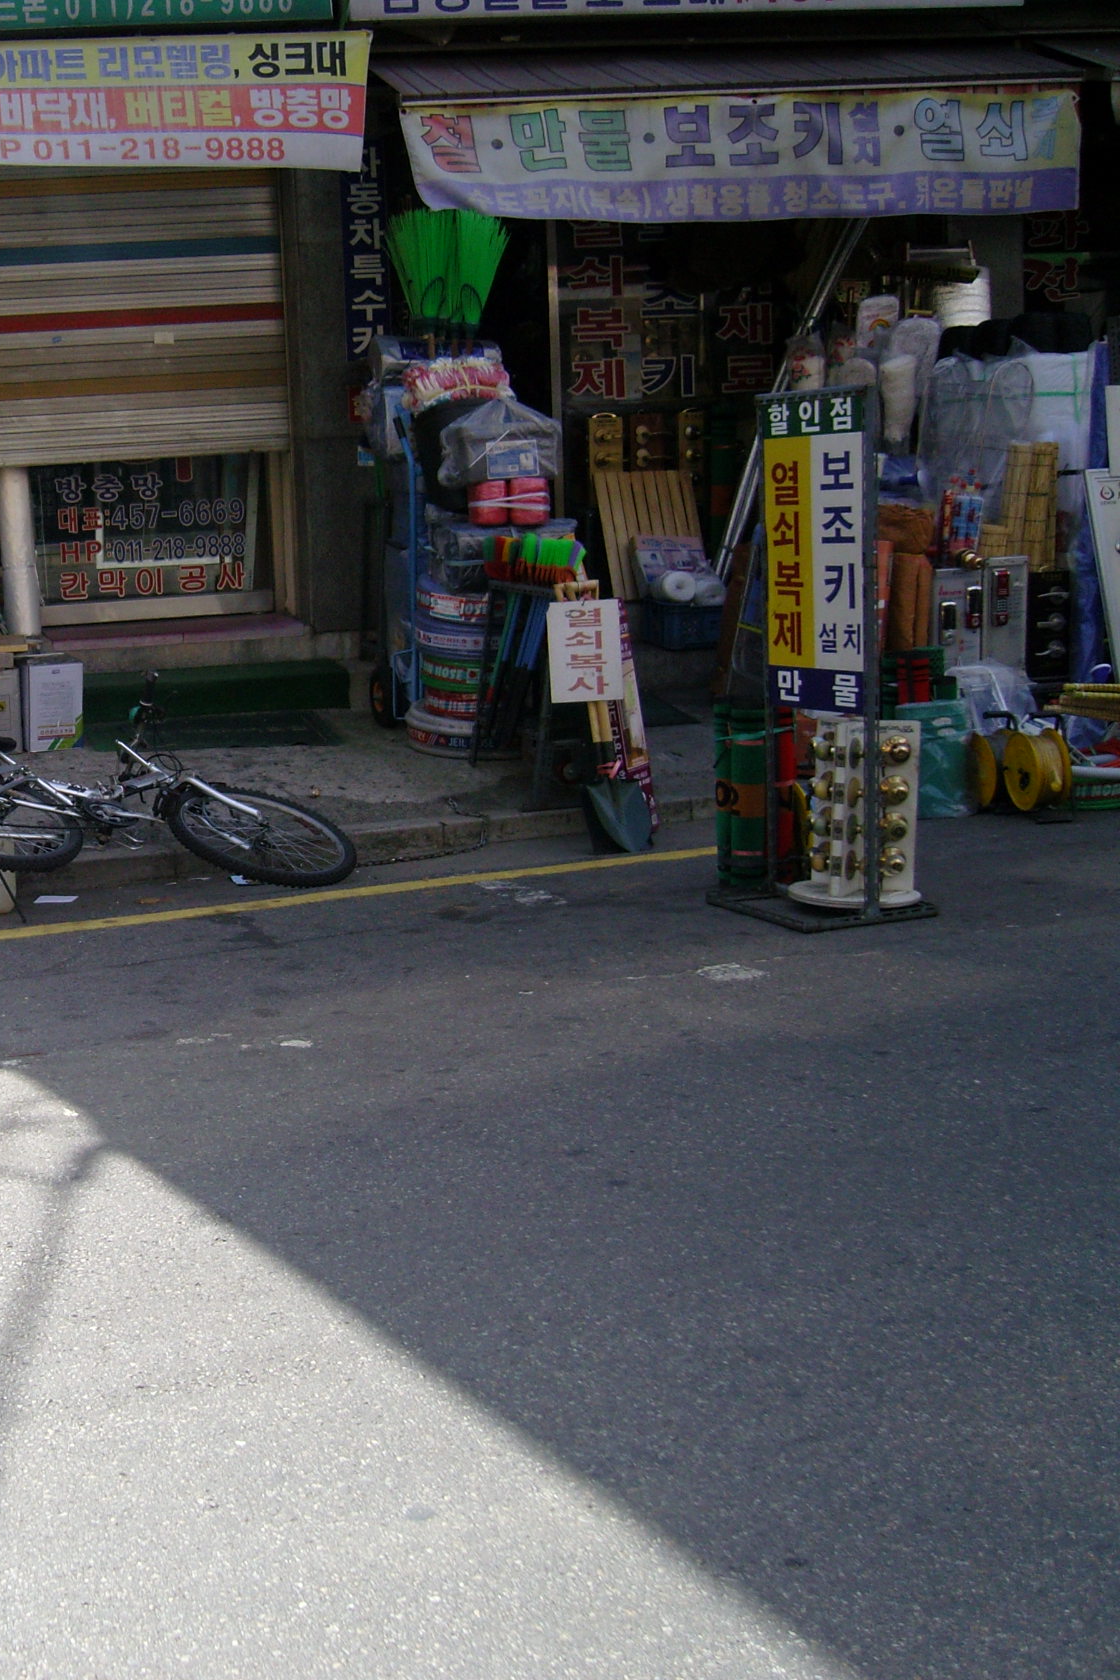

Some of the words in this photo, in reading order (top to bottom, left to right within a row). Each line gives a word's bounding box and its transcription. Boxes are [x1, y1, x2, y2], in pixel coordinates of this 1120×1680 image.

[97, 44, 240, 81] 리모델링,
[247, 41, 347, 78] 싱크대
[123, 90, 241, 128] 버티컬,
[249, 88, 351, 130] 방충망
[32, 136, 286, 162] 011-218-9888
[767, 396, 853, 436] 할인점
[54, 471, 164, 504] 방충망
[819, 450, 857, 610] 보조키
[818, 622, 862, 655] 설치
